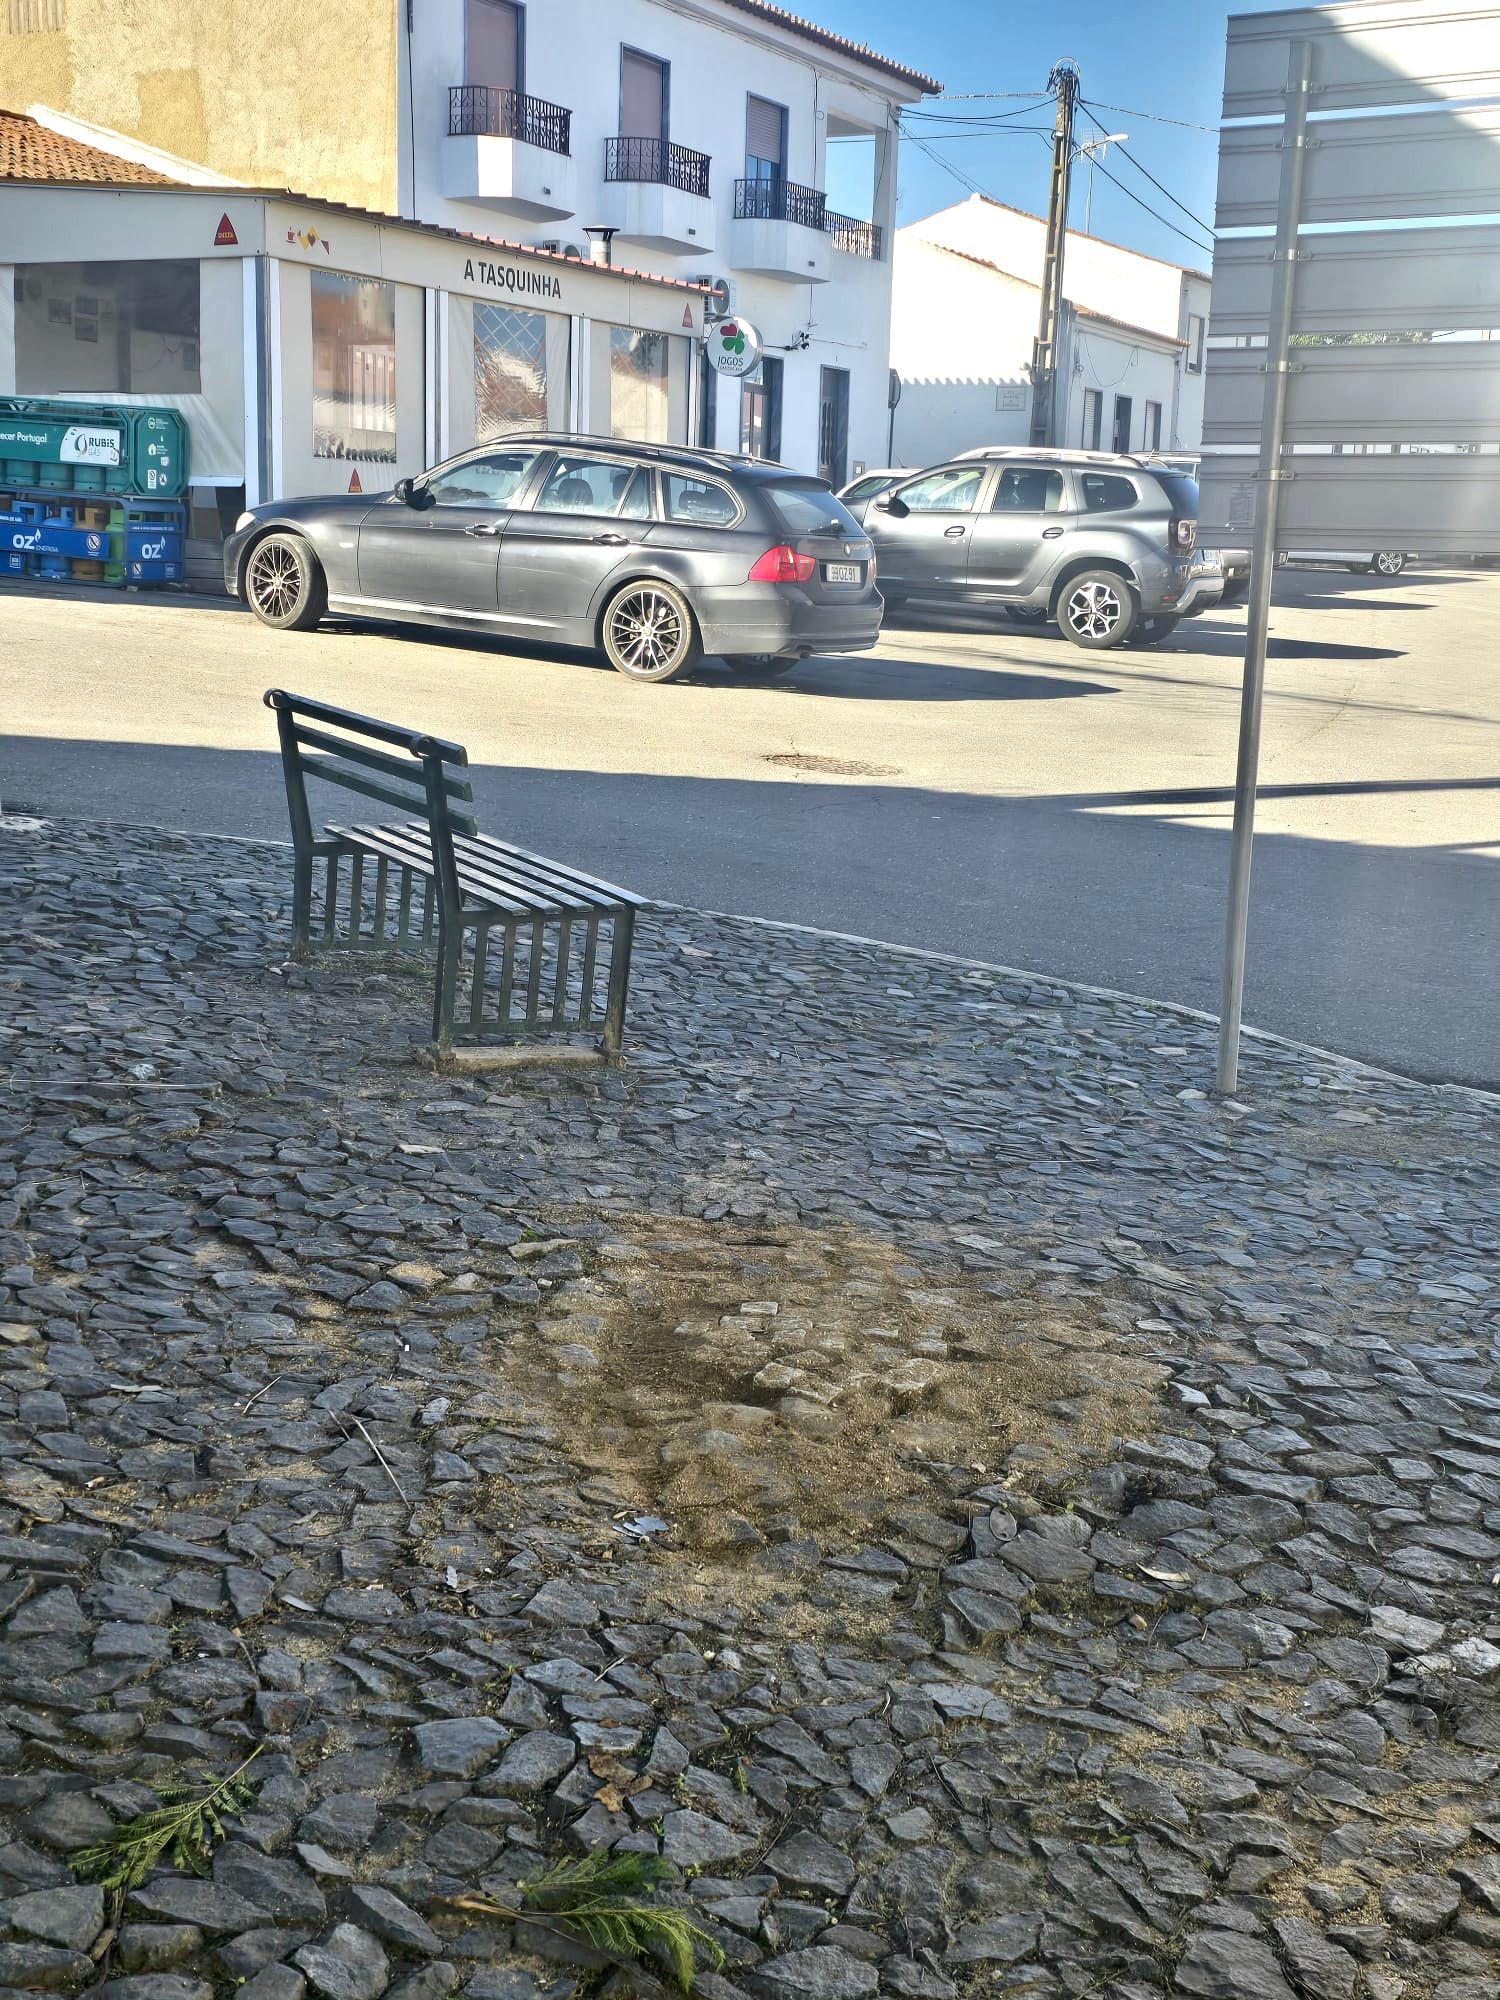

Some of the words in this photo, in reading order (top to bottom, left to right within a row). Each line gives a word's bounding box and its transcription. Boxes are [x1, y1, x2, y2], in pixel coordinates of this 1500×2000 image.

[464, 258, 475, 281] A
[478, 261, 561, 299] TASQUINHA
[717, 356, 744, 367] JOGOS
[16, 432, 48, 445] Portugal
[12, 534, 35, 550] OZ
[141, 544, 162, 559] OZ
